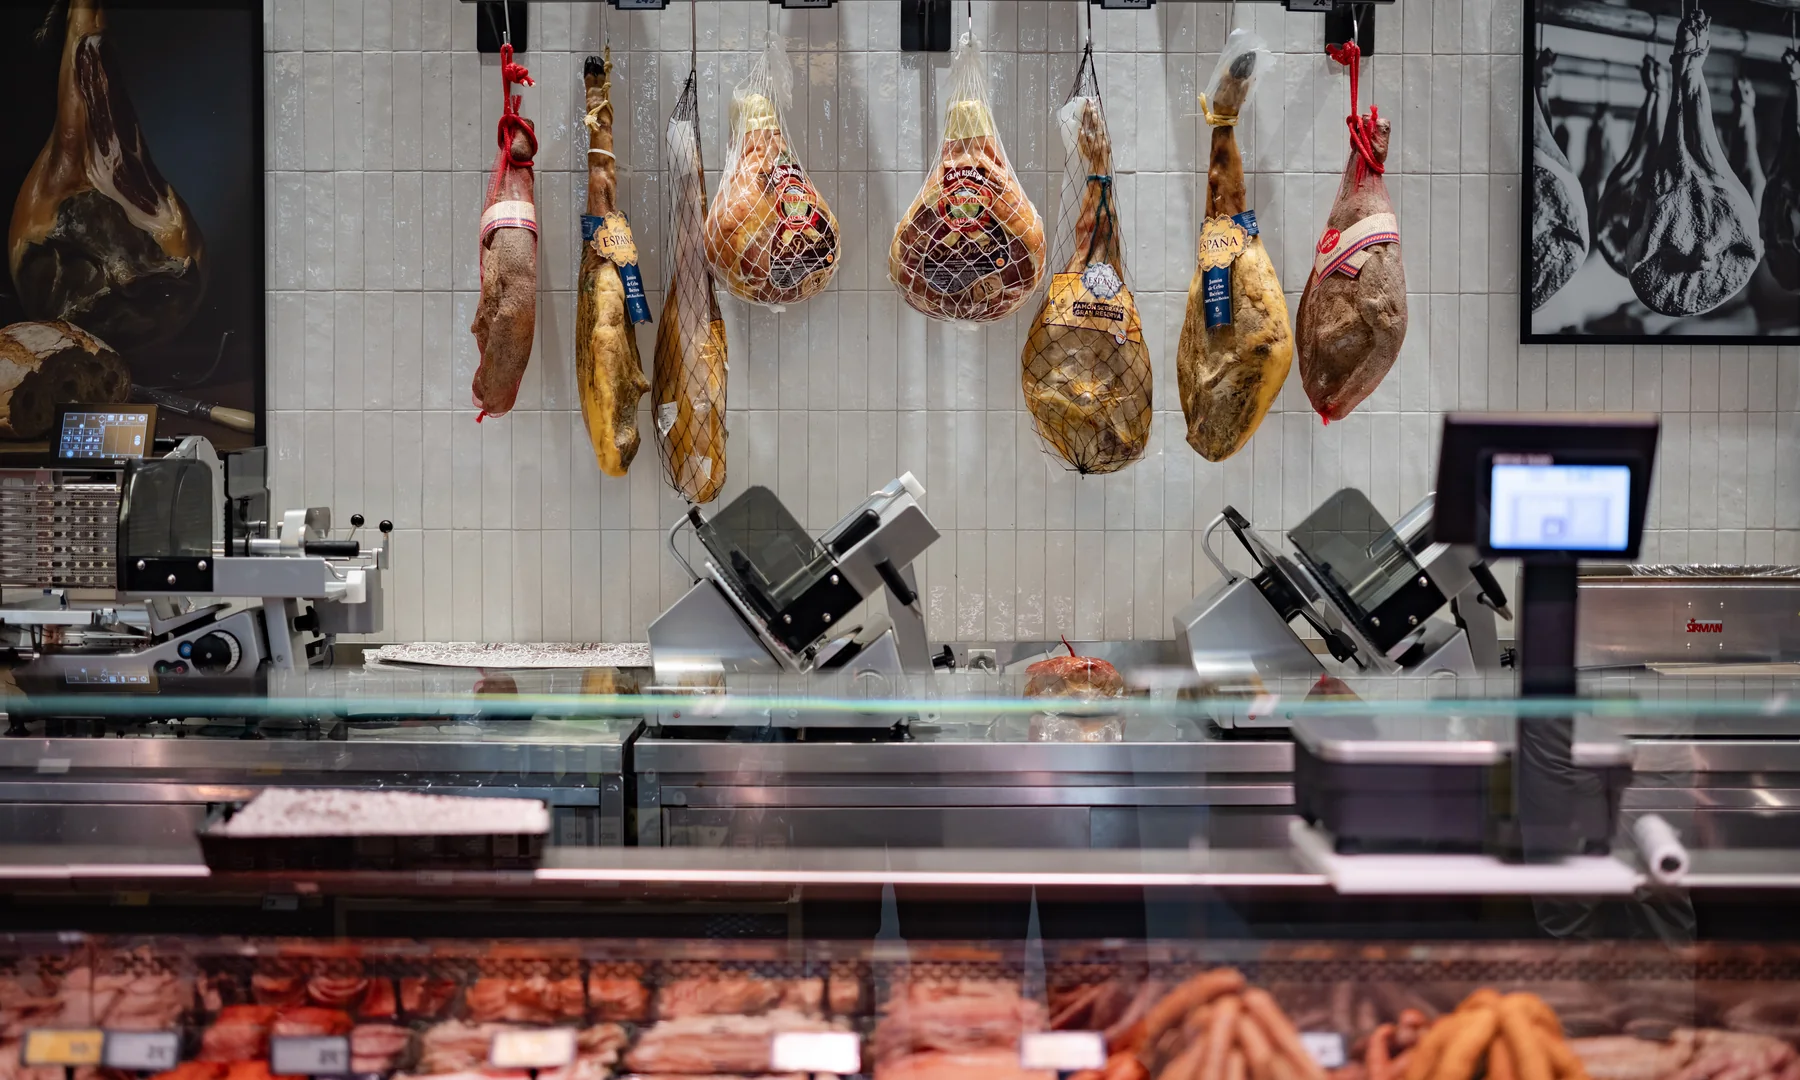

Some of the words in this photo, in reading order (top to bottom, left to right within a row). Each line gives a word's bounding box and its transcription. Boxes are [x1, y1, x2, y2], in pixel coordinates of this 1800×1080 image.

[946, 170, 961, 181] GRAN
[1200, 236, 1238, 252] ESPAÑA
[1686, 620, 1723, 633] SIRMAN
